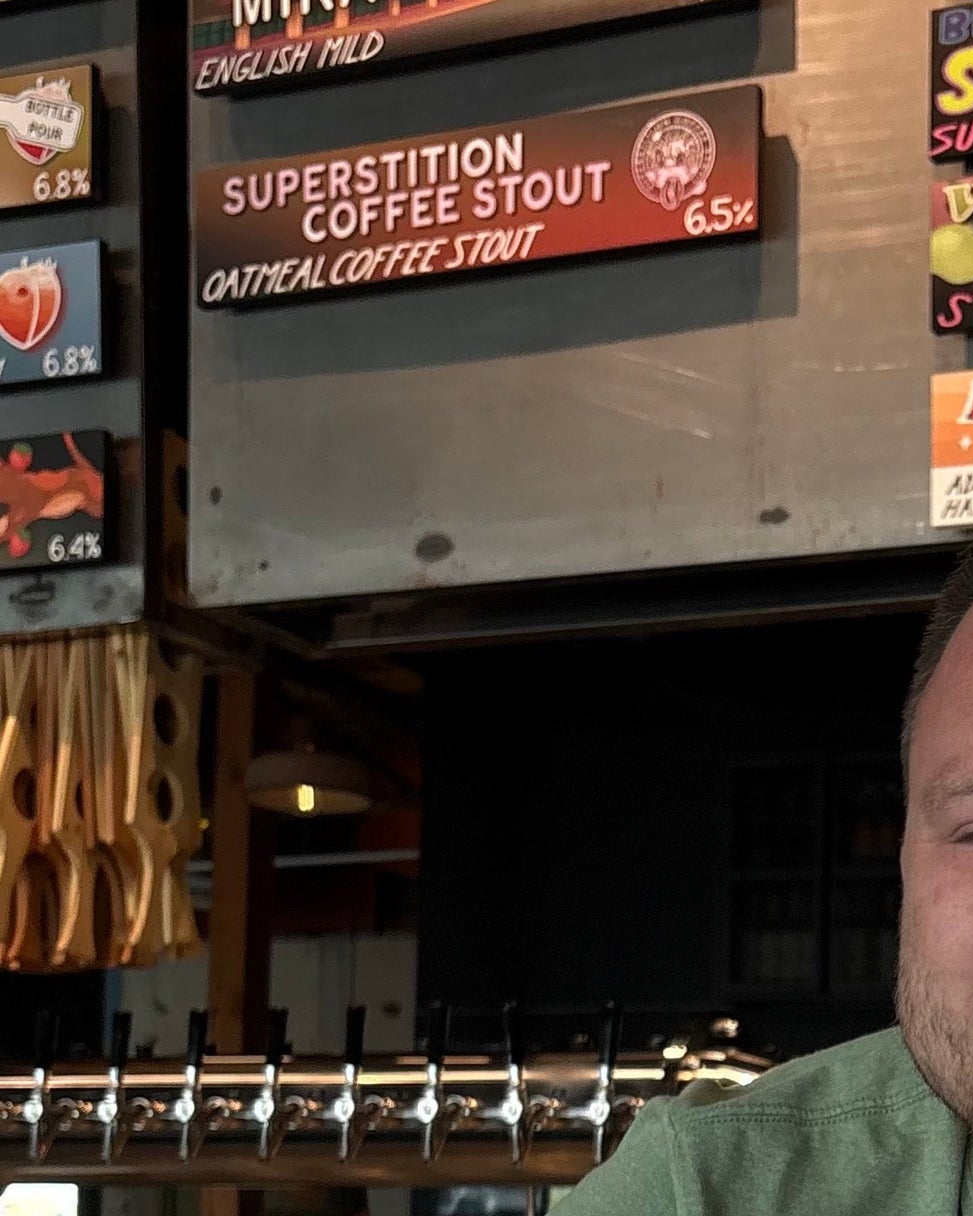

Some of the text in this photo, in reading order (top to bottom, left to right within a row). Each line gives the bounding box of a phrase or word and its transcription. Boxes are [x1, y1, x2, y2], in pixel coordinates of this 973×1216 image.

[195, 30, 385, 90] ENGLISH MILD
[25, 100, 74, 122] BOTTLE
[27, 121, 63, 140] POUR
[33, 168, 91, 200] 6.8%
[222, 131, 524, 216] SUPERSTITION
[301, 159, 612, 243] COFFEE STOUT
[682, 193, 755, 236] 6.5%
[202, 221, 546, 302] OATMEAL COFFEE STOUT
[42, 345, 97, 377] 6.8%
[47, 531, 101, 562] 6.4%
